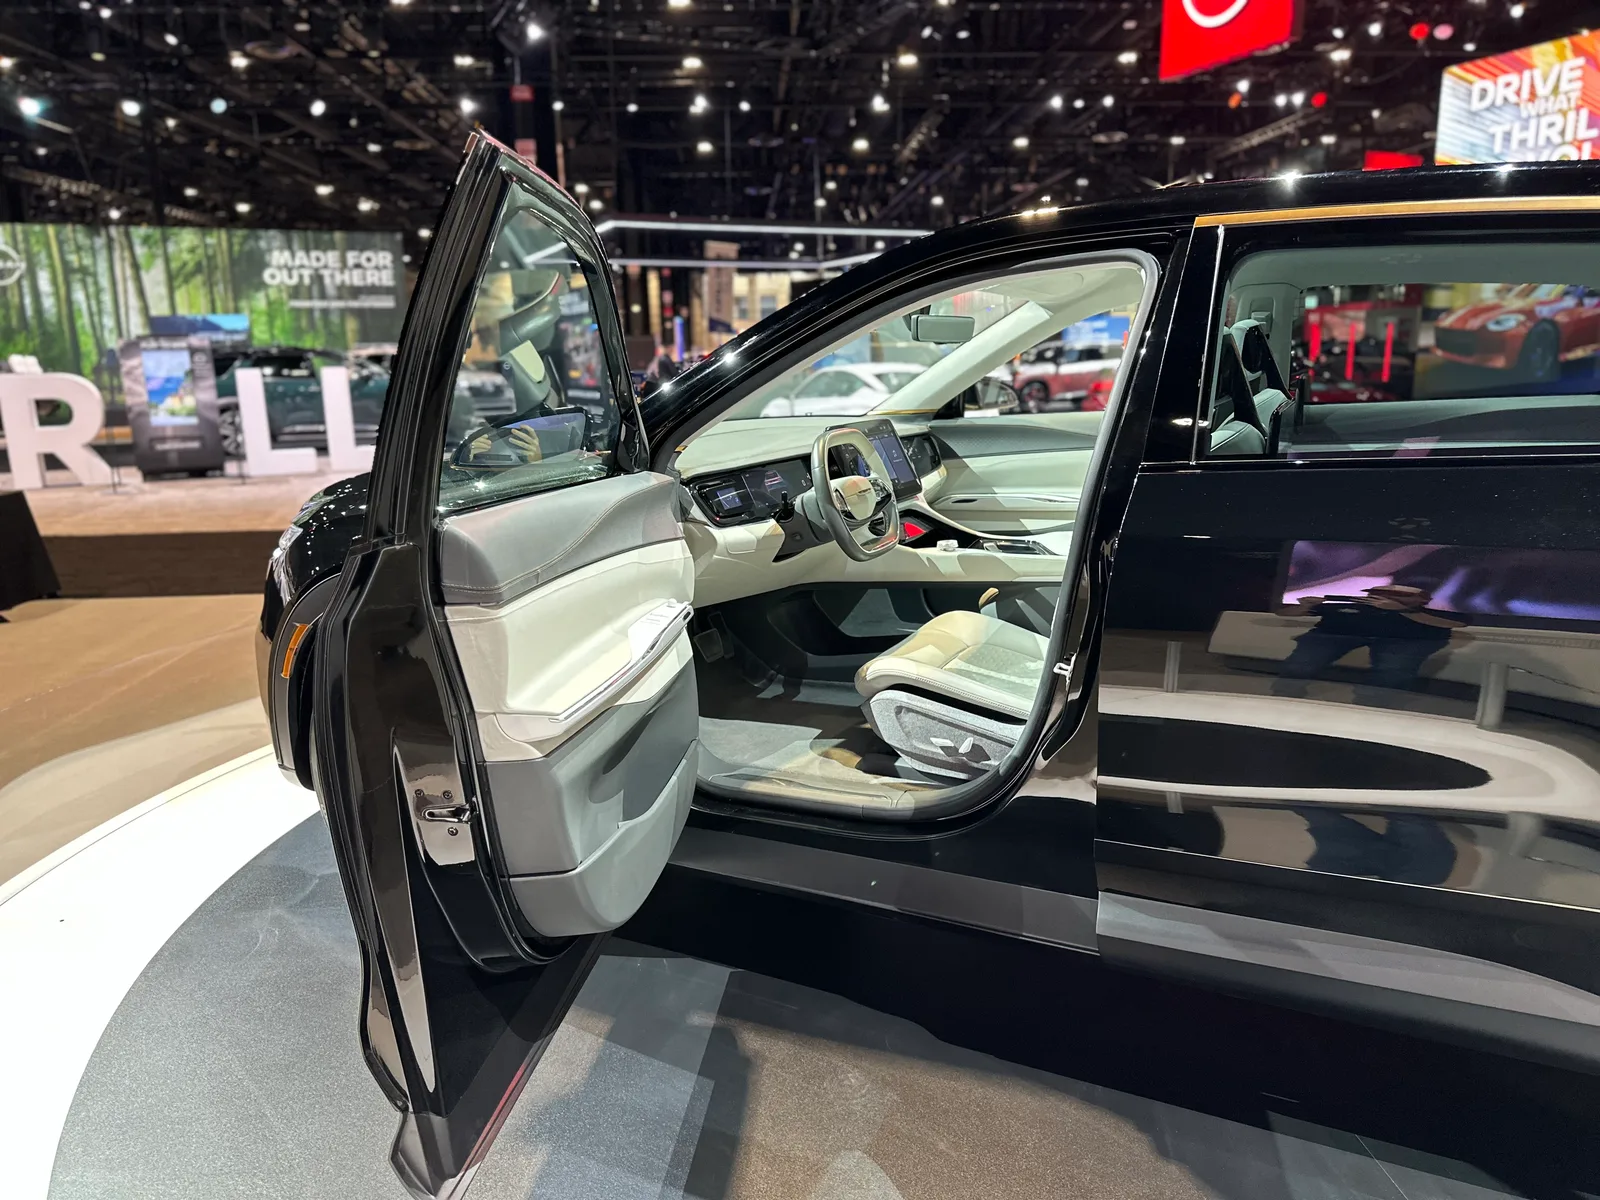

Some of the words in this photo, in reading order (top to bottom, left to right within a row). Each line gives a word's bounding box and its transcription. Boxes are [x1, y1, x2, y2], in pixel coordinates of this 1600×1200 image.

[1471, 57, 1585, 111] DRIVE
[1520, 91, 1581, 119] WHAT
[270, 249, 341, 268] MADE
[345, 249, 394, 268] FOR
[262, 267, 313, 286] OUT
[318, 267, 396, 287] THERE
